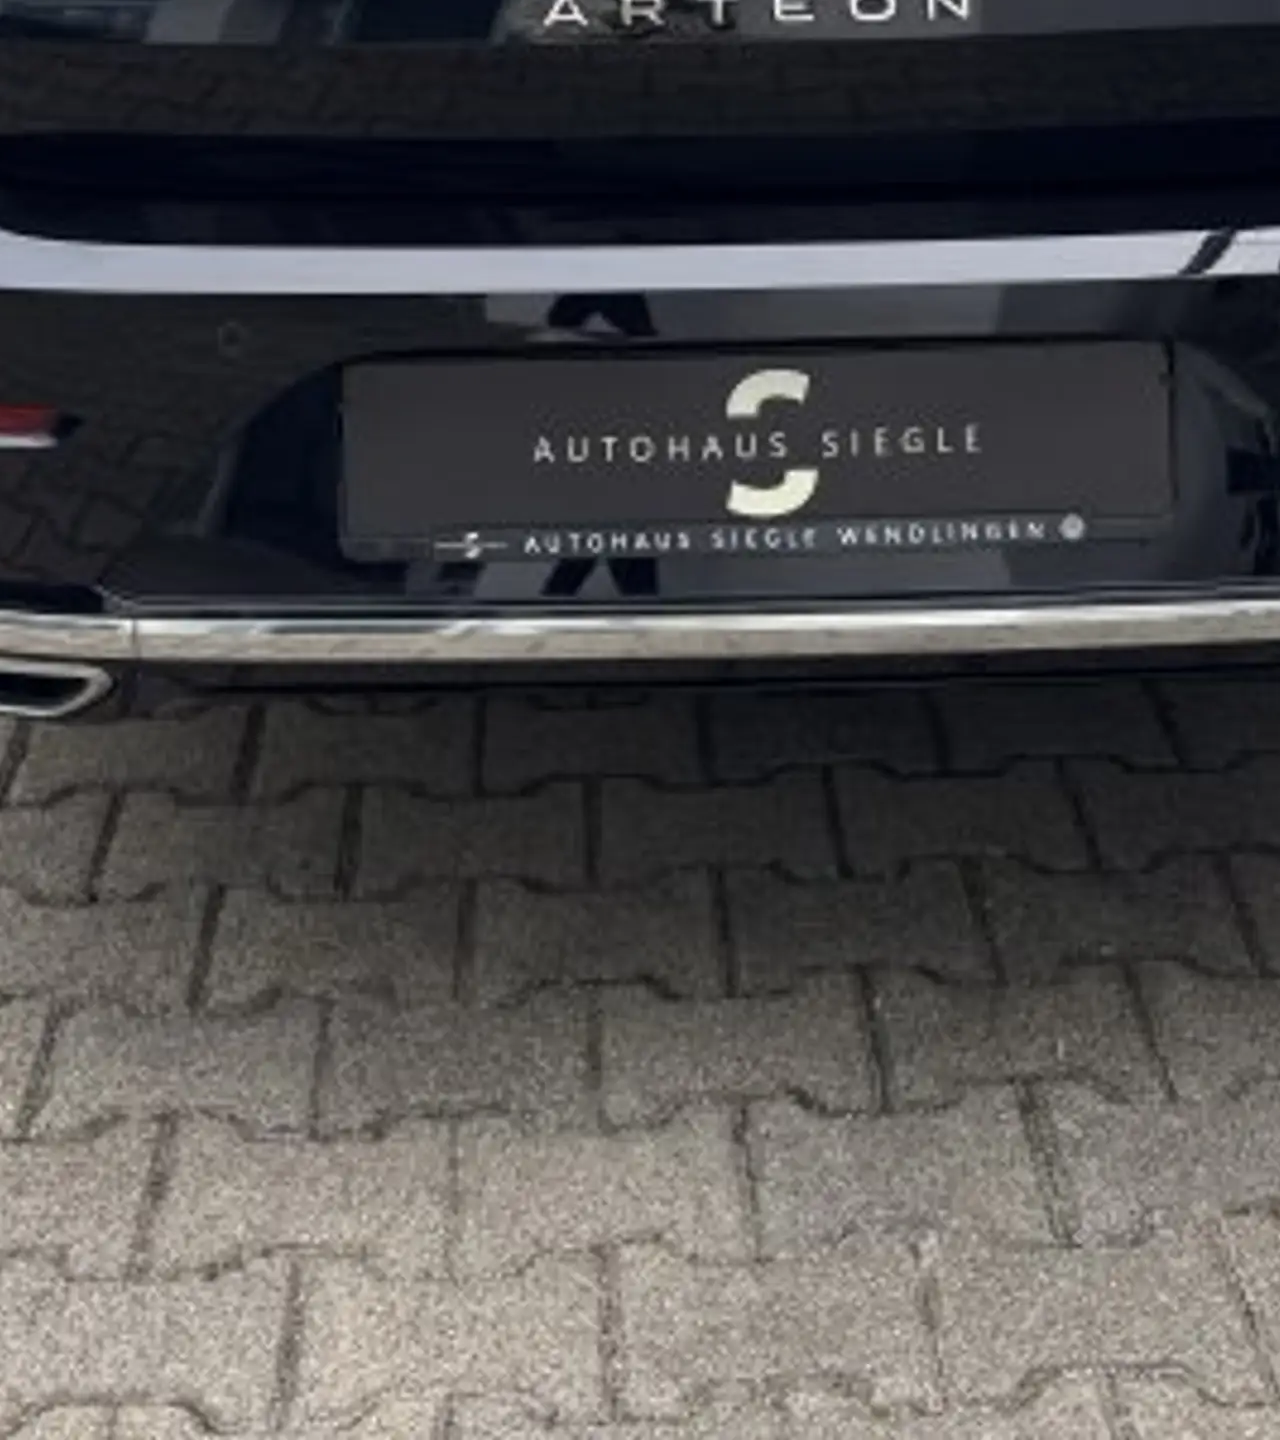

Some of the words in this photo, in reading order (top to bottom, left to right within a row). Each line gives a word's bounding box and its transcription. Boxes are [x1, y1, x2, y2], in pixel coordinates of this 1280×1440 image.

[532, 430, 789, 464] AUTOHAUS
[820, 423, 984, 458] SIEGLE
[522, 528, 692, 555] AUTOHAUS
[711, 527, 818, 550] SIEGLE
[835, 520, 1045, 546] WENDLINGEN
